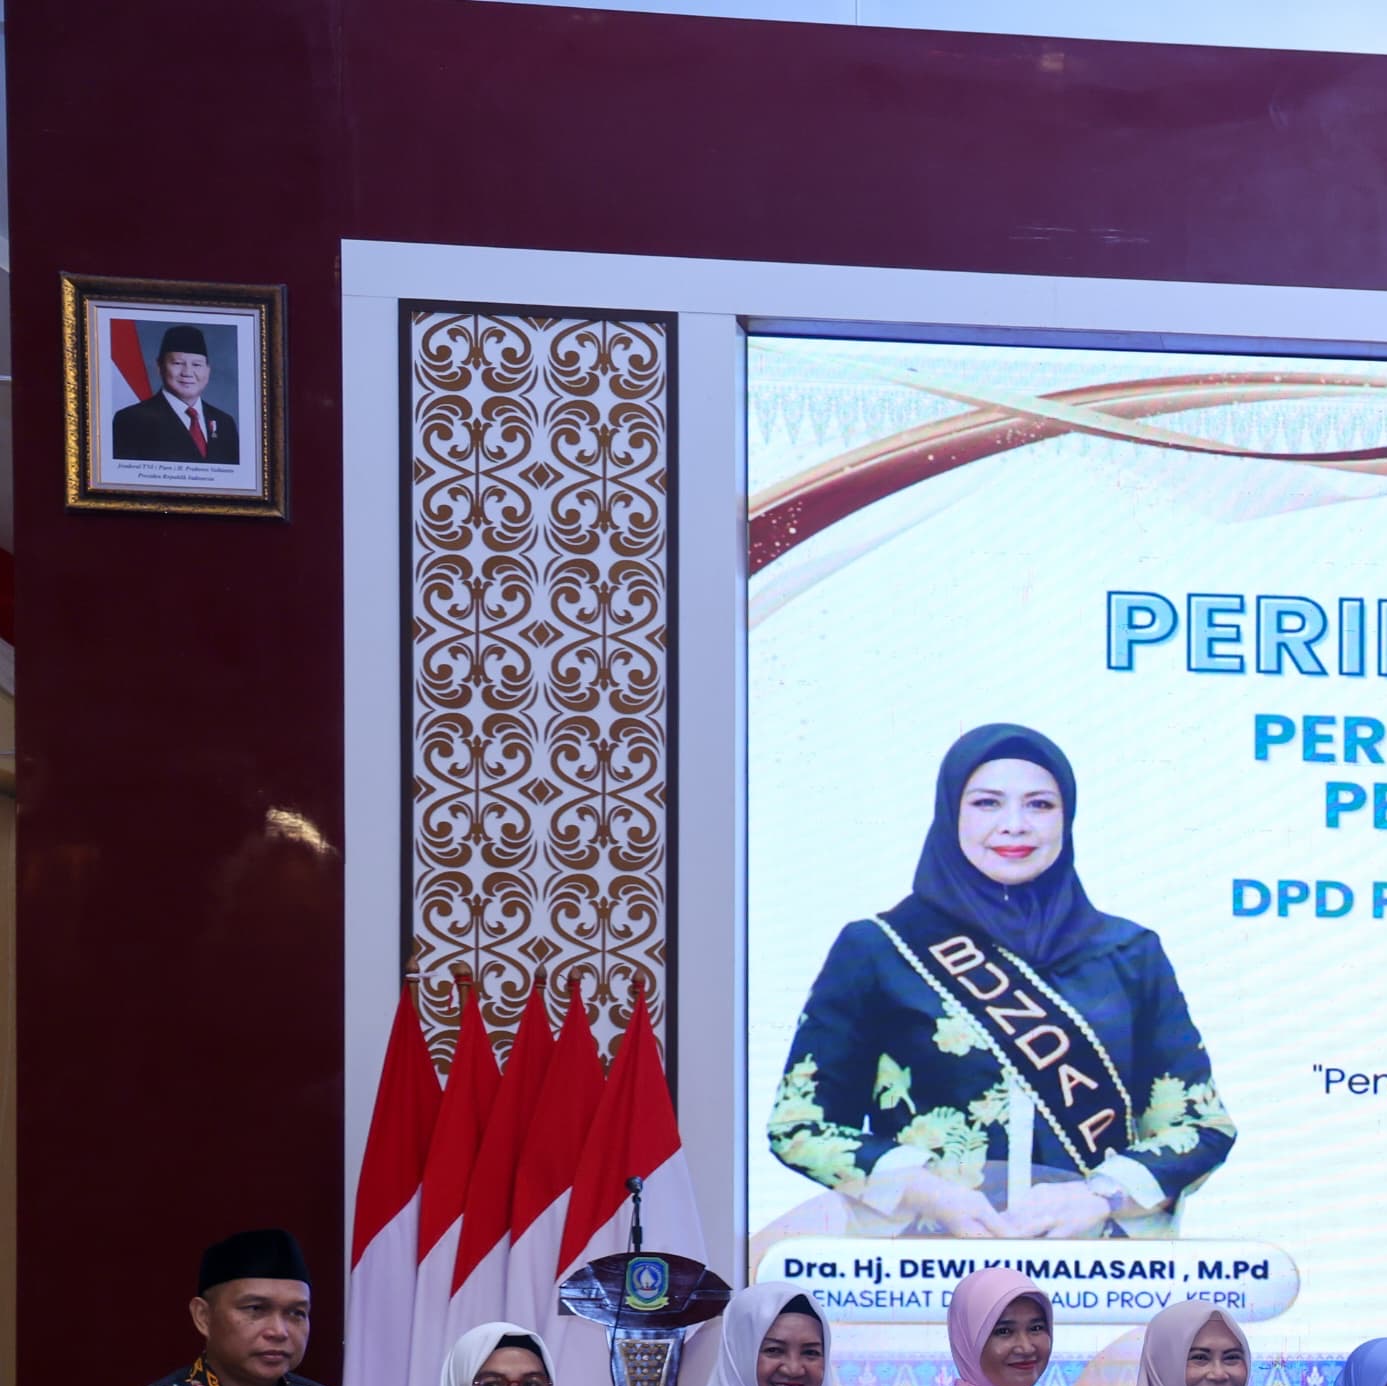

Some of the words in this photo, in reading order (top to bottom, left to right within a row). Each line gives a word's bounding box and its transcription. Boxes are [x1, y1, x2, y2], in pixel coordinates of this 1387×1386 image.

[1232, 878, 1354, 918] DPD
[783, 1257, 845, 1279] Dra.
[854, 1256, 891, 1285] Hj.
[1197, 1259, 1270, 1280] M.Pd
[812, 1289, 933, 1308] ENASEHAT
